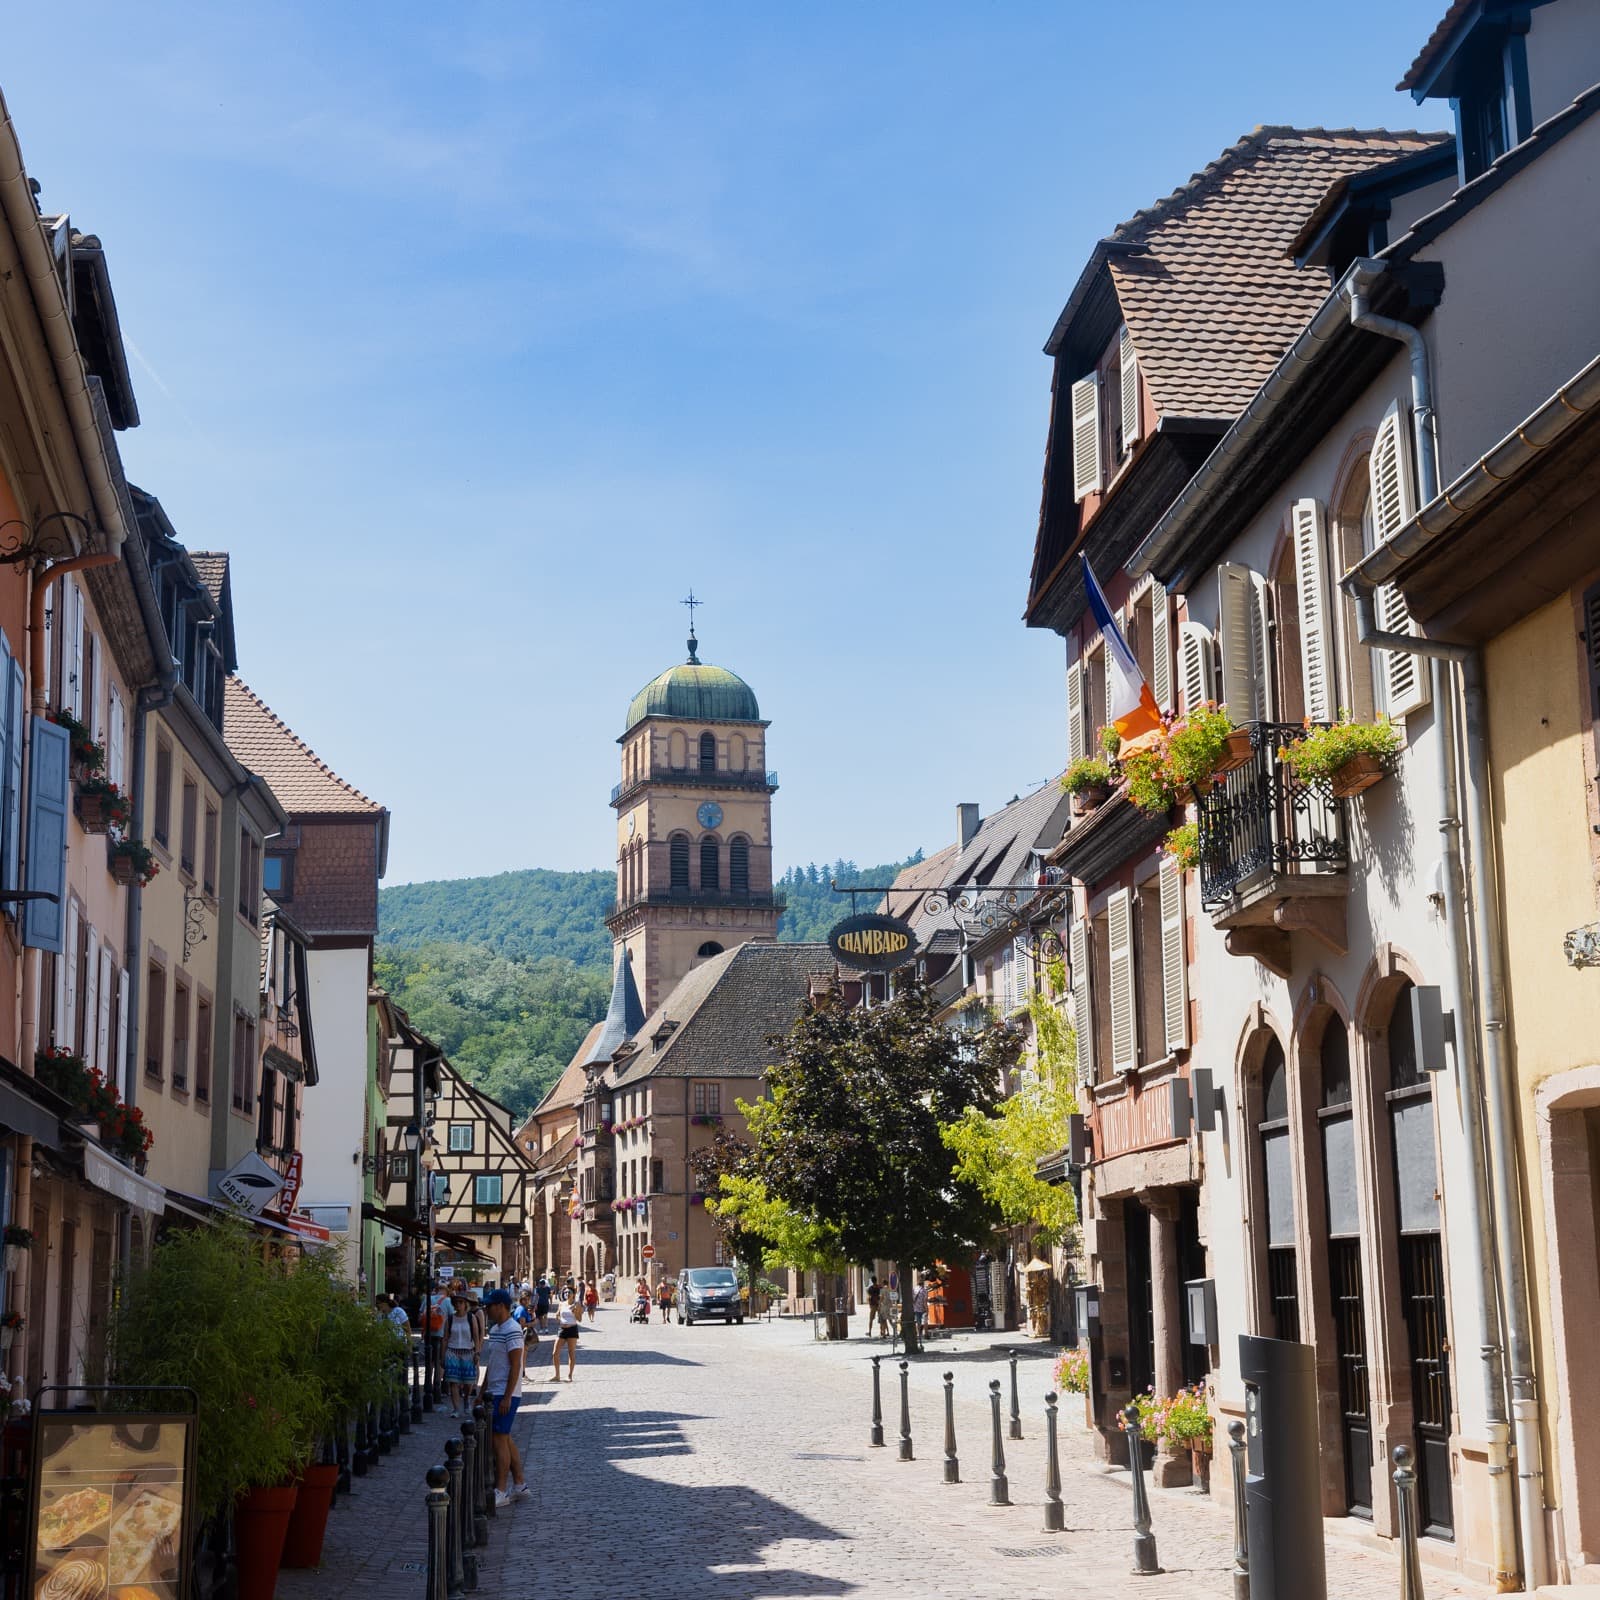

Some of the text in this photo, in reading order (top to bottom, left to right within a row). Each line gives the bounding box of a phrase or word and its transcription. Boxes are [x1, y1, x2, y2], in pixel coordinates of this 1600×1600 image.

[838, 930, 908, 954] CHAMBARD
[1143, 1084, 1171, 1145] CHAMBA
[223, 1180, 256, 1213] PRESSE
[281, 1155, 301, 1214] TABAC
